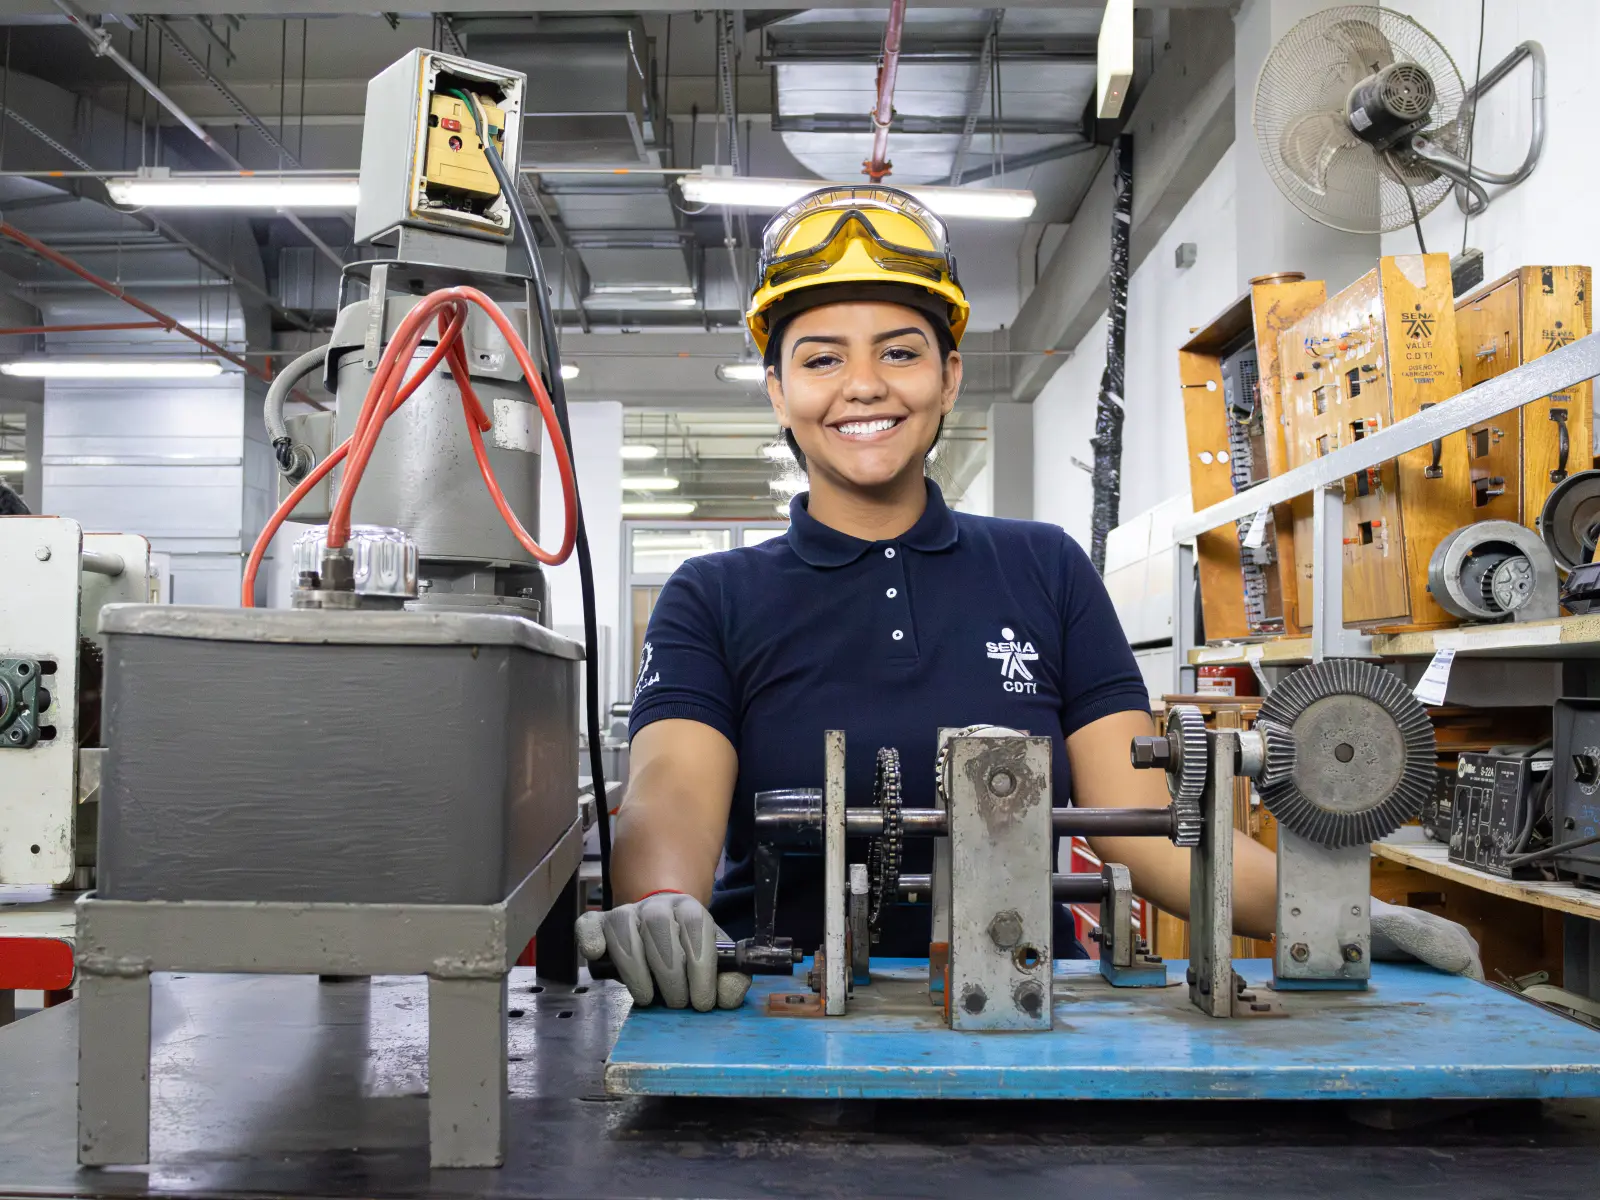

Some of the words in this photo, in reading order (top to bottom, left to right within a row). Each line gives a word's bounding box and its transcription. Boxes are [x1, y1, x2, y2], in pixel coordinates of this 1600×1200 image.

[1405, 341, 1433, 350] VALLE
[985, 641, 1036, 653] SENA
[1003, 681, 1037, 694] CDTI
